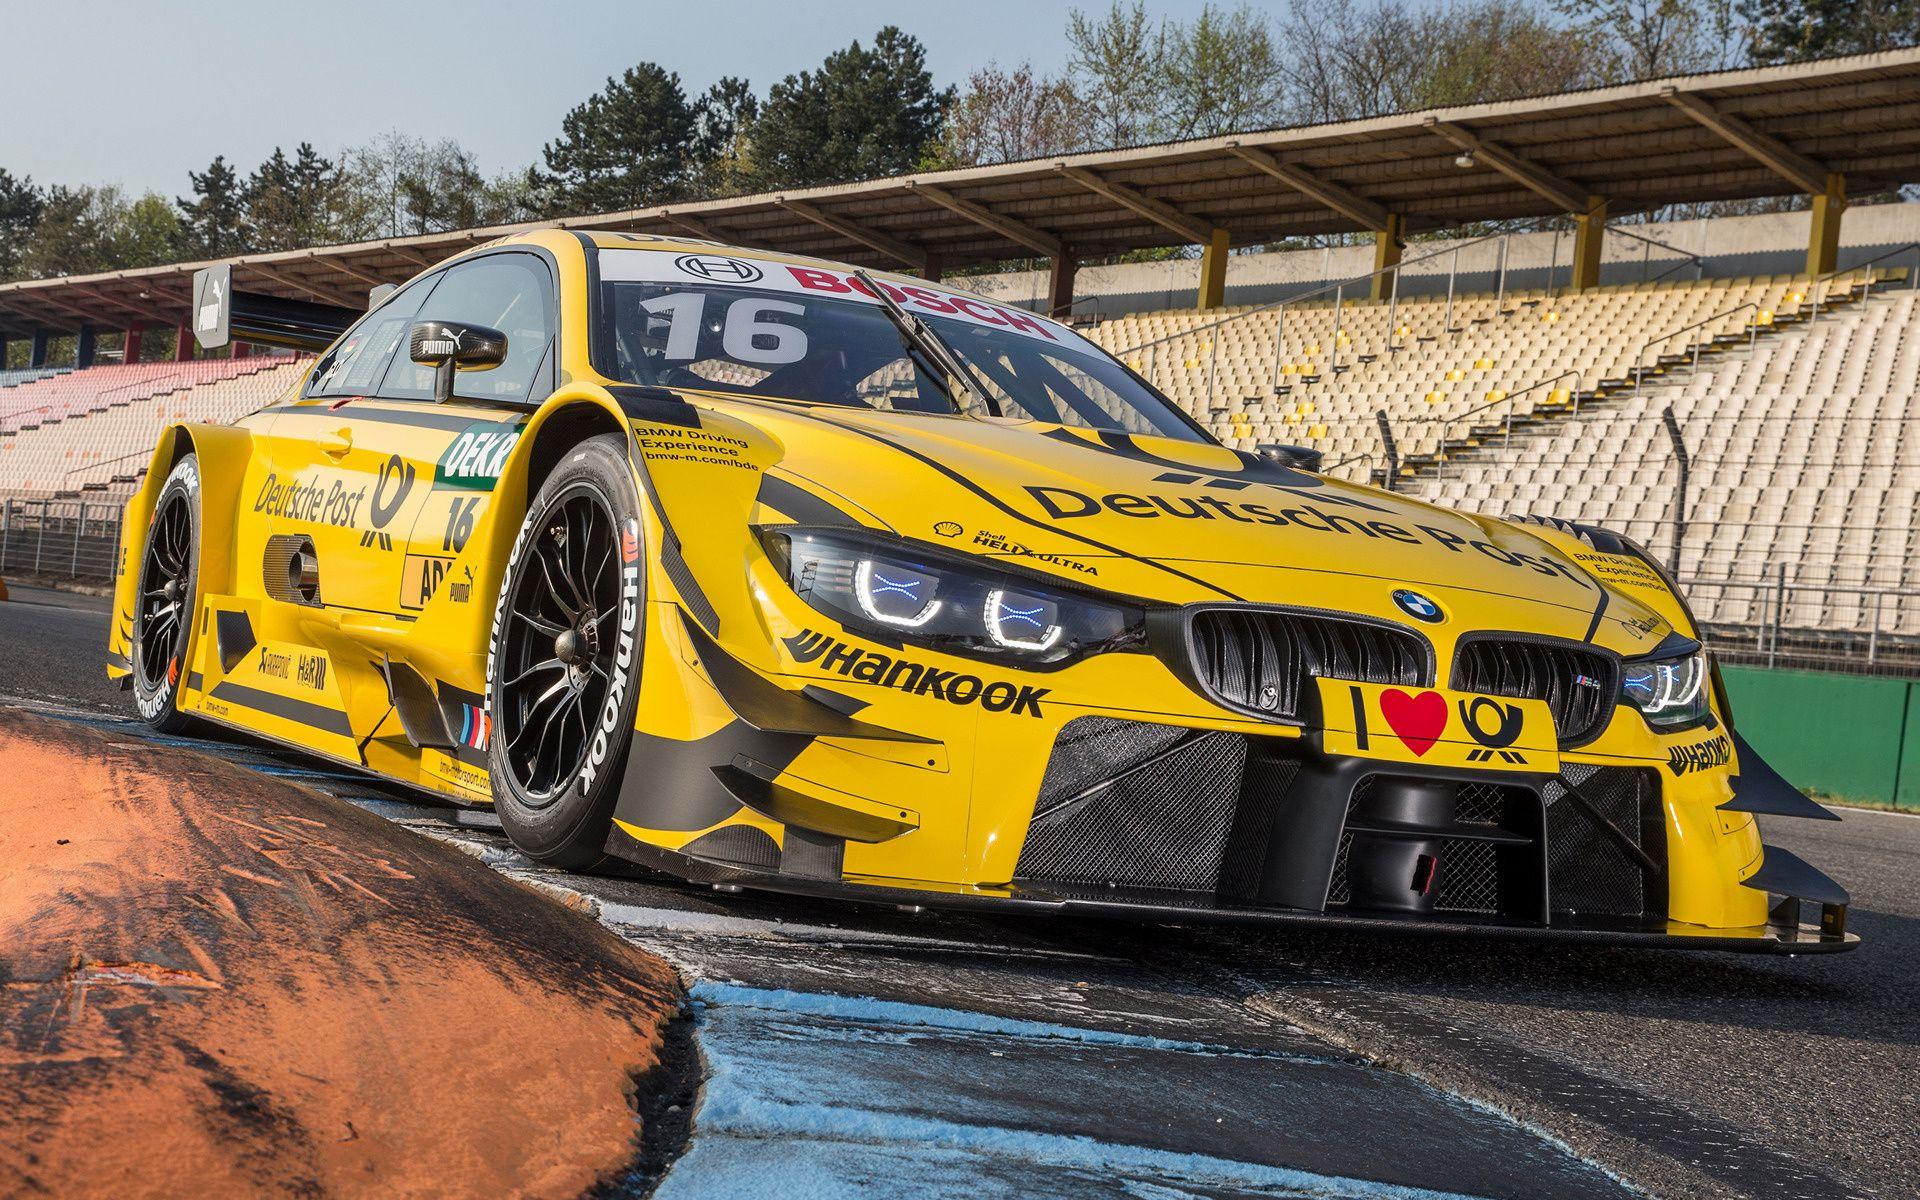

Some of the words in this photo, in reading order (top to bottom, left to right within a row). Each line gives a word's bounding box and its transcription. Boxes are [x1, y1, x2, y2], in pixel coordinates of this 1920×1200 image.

[785, 266, 1059, 341] BOSCH
[639, 292, 808, 364] 16
[422, 340, 454, 355] PUMA
[635, 428, 682, 437] BMW
[687, 431, 749, 449] Driving
[641, 439, 739, 457] Experience
[646, 452, 759, 471] bmw-m.com/bde
[254, 473, 324, 522] Deutsche
[321, 479, 367, 528] Post
[443, 497, 481, 553] 16
[978, 530, 1005, 541] Shell
[1022, 485, 1422, 545] Deutsche
[1413, 524, 1592, 590] Post
[420, 559, 452, 605] AD
[1039, 554, 1098, 576] ULTRA
[450, 583, 470, 603] PUMA
[1350, 686, 1370, 751] I
